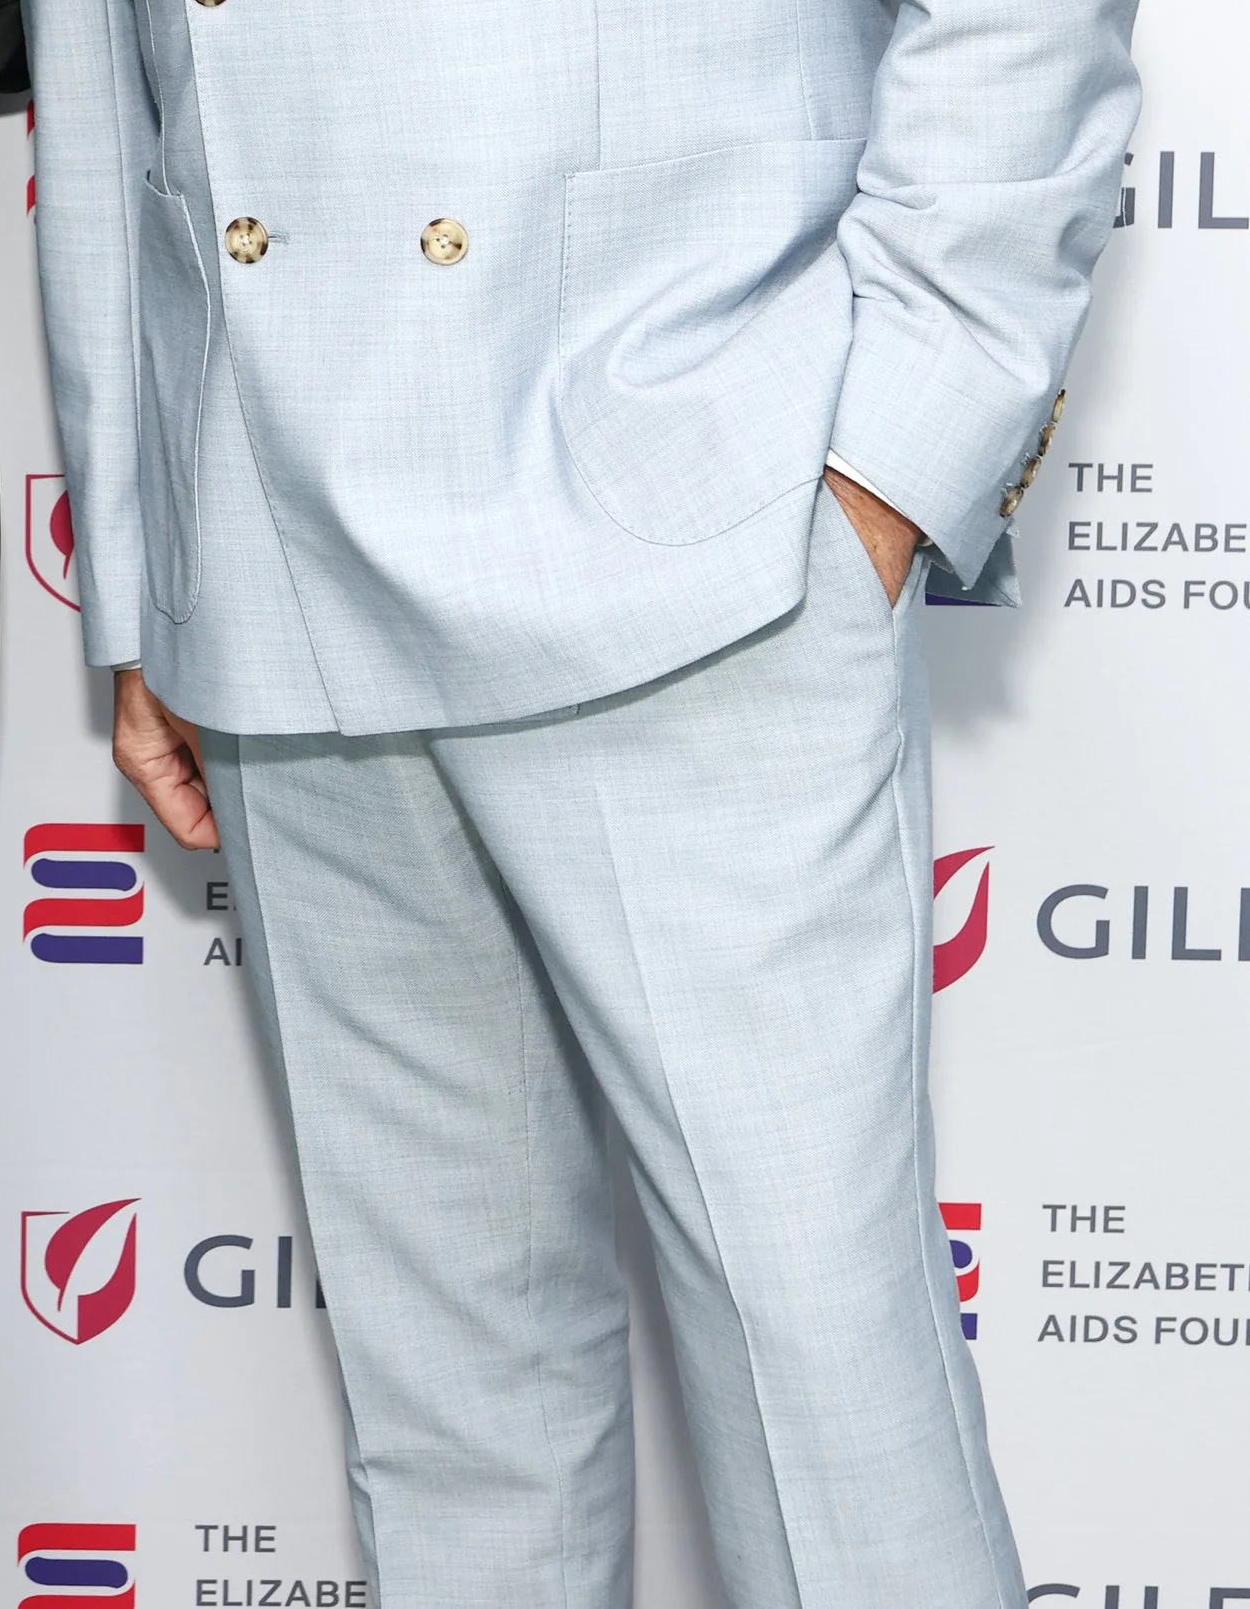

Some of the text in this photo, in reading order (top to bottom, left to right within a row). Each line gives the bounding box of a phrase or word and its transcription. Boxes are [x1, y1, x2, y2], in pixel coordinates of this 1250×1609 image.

[1068, 462, 1154, 493] THE
[1067, 520, 1247, 553] ELIZABE
[1063, 578, 1167, 610] AIDS
[1036, 883, 1250, 962] GIL
[1041, 1204, 1126, 1234] THE
[183, 1233, 328, 1309] GI
[1041, 1259, 1250, 1292] ELIZABET
[1037, 1314, 1250, 1347] AIDS FOU
[194, 1524, 277, 1553] THE
